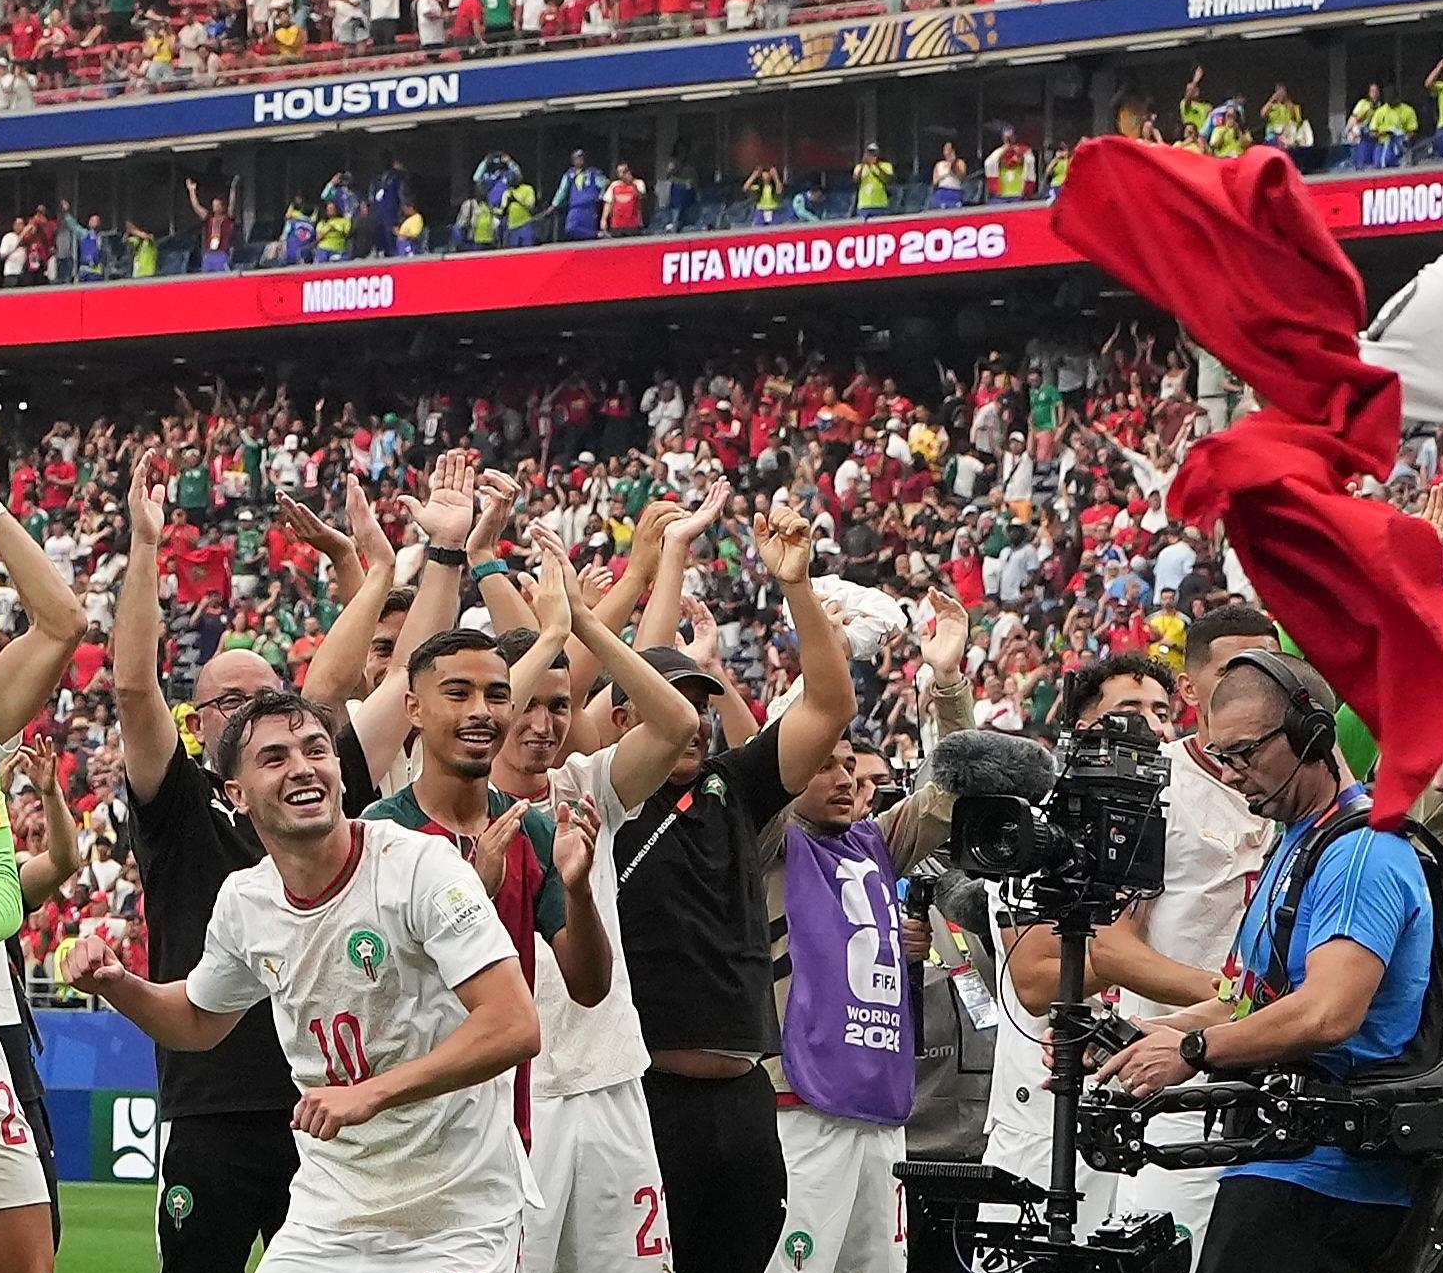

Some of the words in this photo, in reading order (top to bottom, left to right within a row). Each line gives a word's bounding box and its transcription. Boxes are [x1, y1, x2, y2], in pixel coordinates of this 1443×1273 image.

[253, 73, 460, 123] HOUSTON
[662, 249, 726, 285] FIFA
[727, 238, 833, 279] WORLD
[835, 233, 896, 270] CUP
[898, 223, 1007, 265] 2026
[302, 274, 394, 314] MOROCCO
[648, 832, 660, 846] CUP
[872, 972, 897, 992] FIFA
[308, 1011, 372, 1087] 10
[633, 1185, 668, 1257] 2
